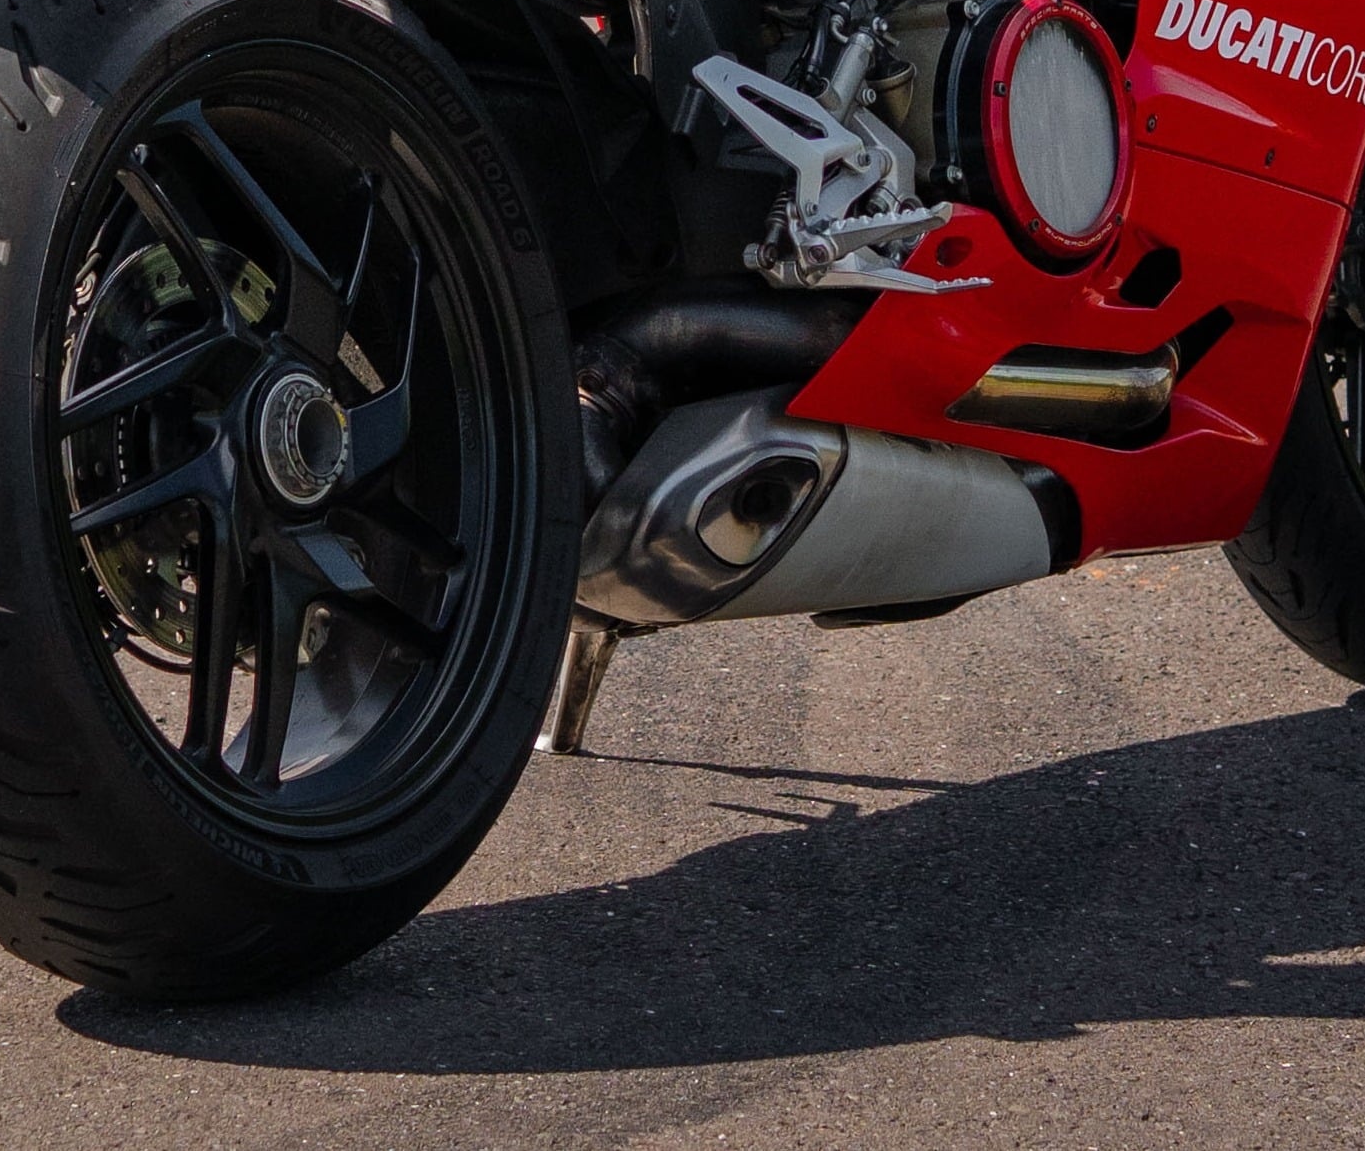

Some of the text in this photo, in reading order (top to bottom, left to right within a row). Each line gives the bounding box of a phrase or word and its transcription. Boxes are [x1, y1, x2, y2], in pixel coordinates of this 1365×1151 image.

[1020, 5, 1098, 40] SPECIAL PARTS
[356, 20, 468, 126] MICHELIN
[472, 143, 520, 220] ROAD
[152, 774, 264, 868] MICHELIN
